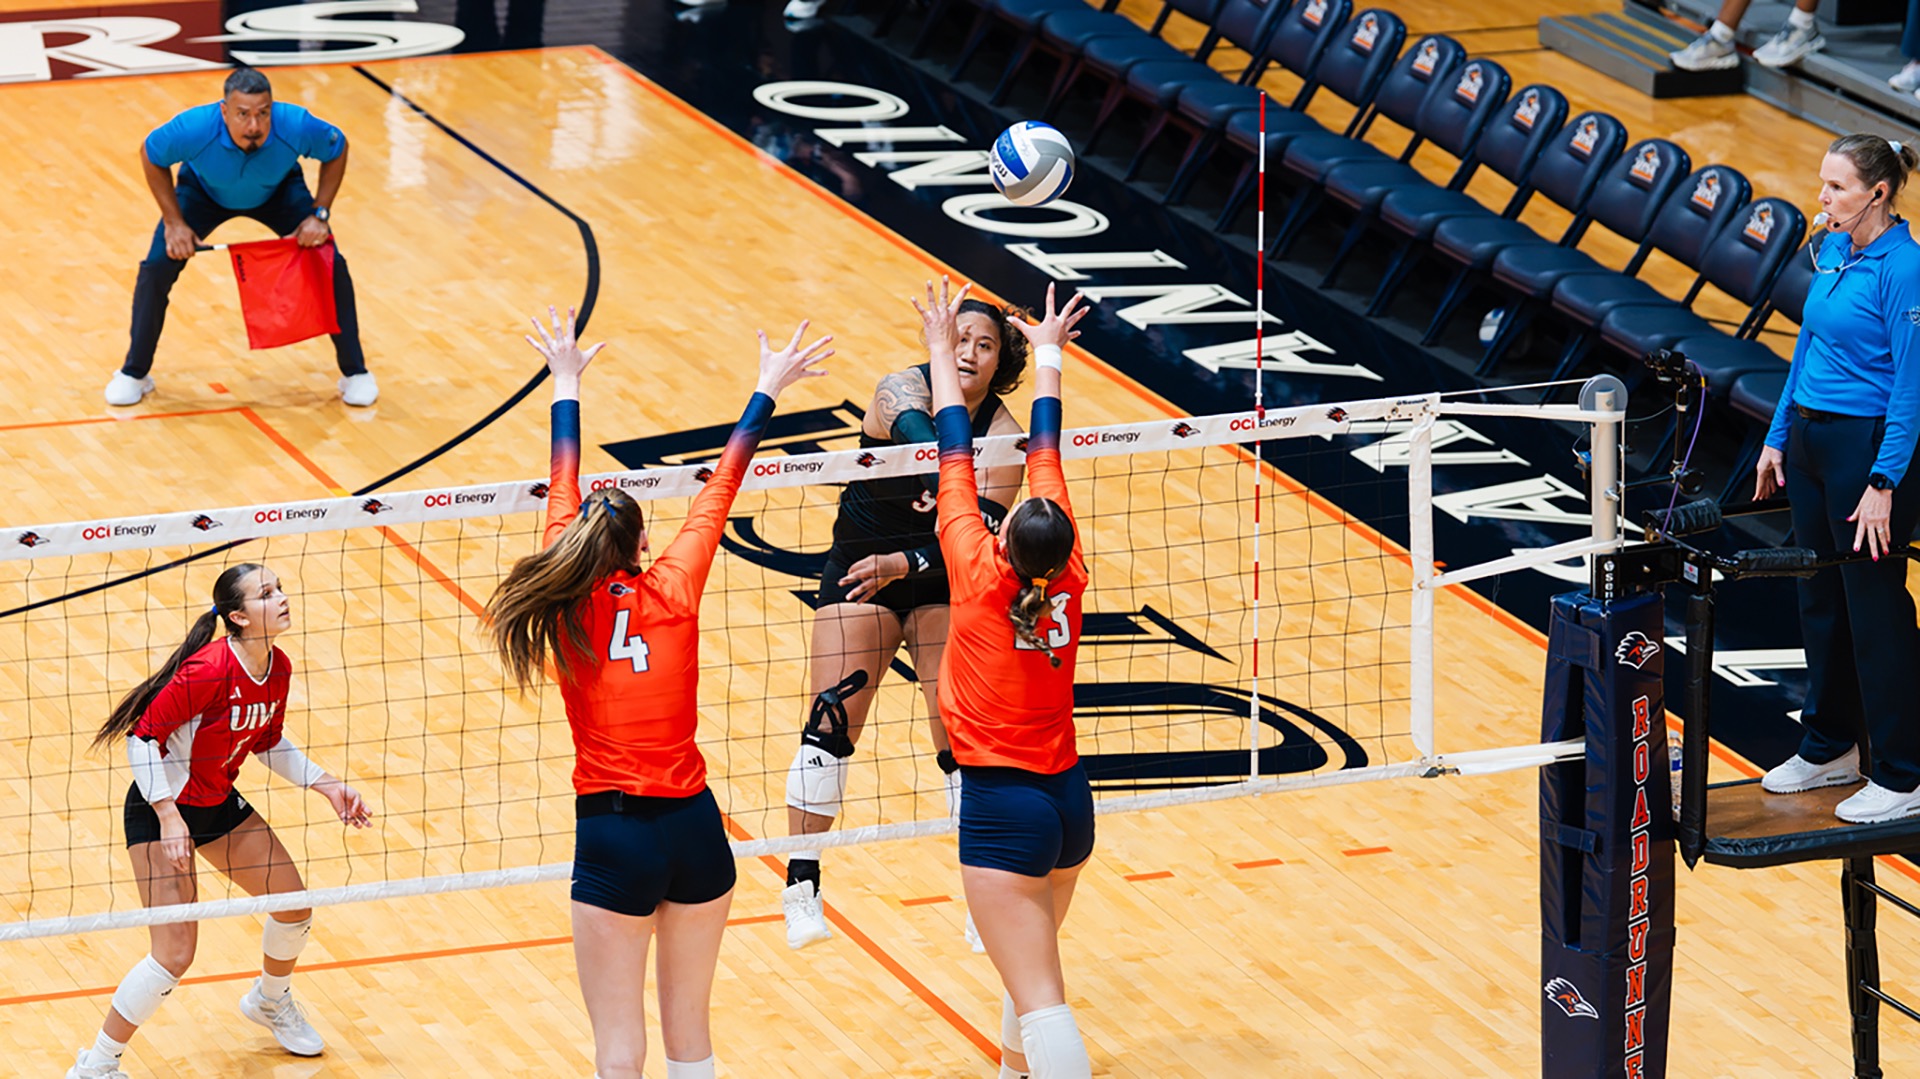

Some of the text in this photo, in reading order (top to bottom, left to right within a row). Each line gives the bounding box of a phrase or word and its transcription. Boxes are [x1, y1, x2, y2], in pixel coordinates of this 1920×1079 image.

[1258, 414, 1298, 429] Energy
[1101, 429, 1141, 444] Energy
[915, 447, 939, 461] OC
[784, 459, 824, 474] Energy
[620, 475, 661, 490] Energy
[455, 491, 496, 506] Energy
[286, 506, 328, 521] Energy
[114, 522, 156, 538] Energy
[608, 608, 651, 673] 4
